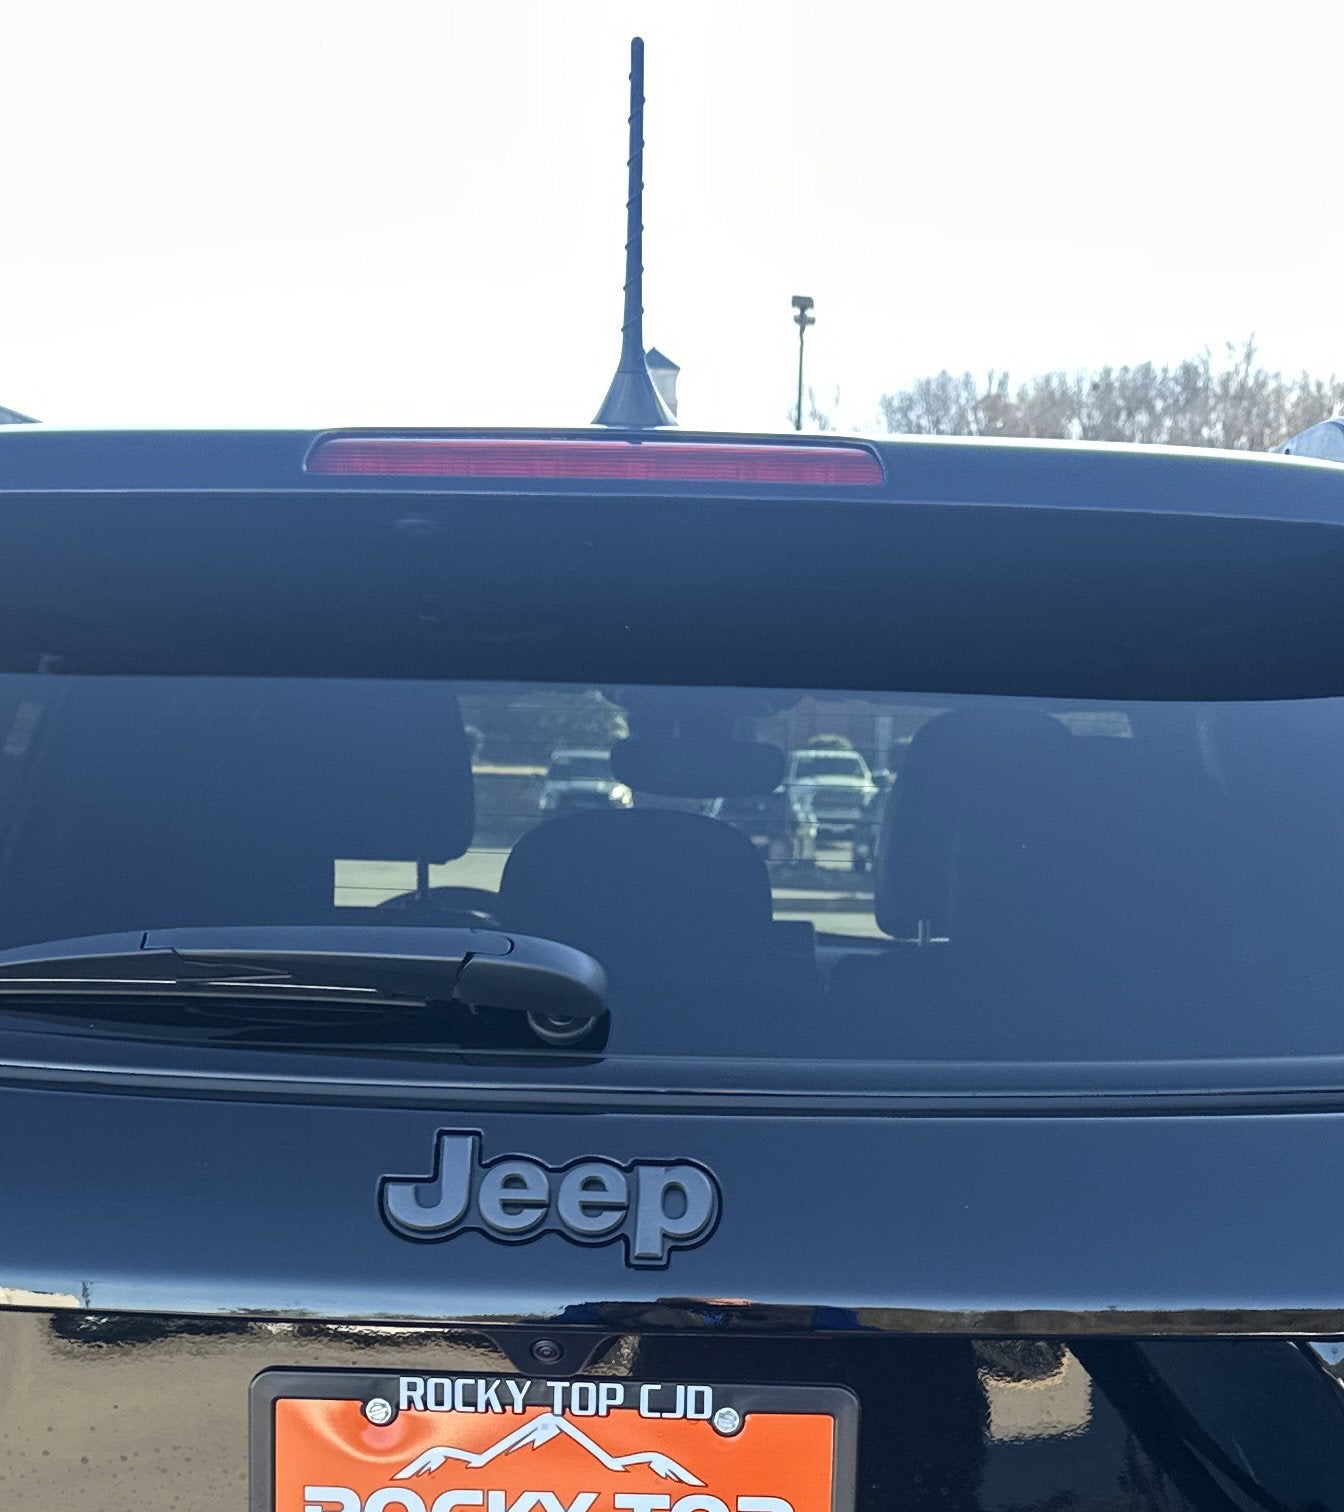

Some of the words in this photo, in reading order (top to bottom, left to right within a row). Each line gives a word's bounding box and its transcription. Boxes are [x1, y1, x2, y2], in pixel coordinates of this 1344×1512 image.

[382, 1130, 718, 1266] Jeep
[399, 1375, 531, 1414] ROCKY
[546, 1379, 625, 1418] TOP
[639, 1383, 714, 1421] CJD
